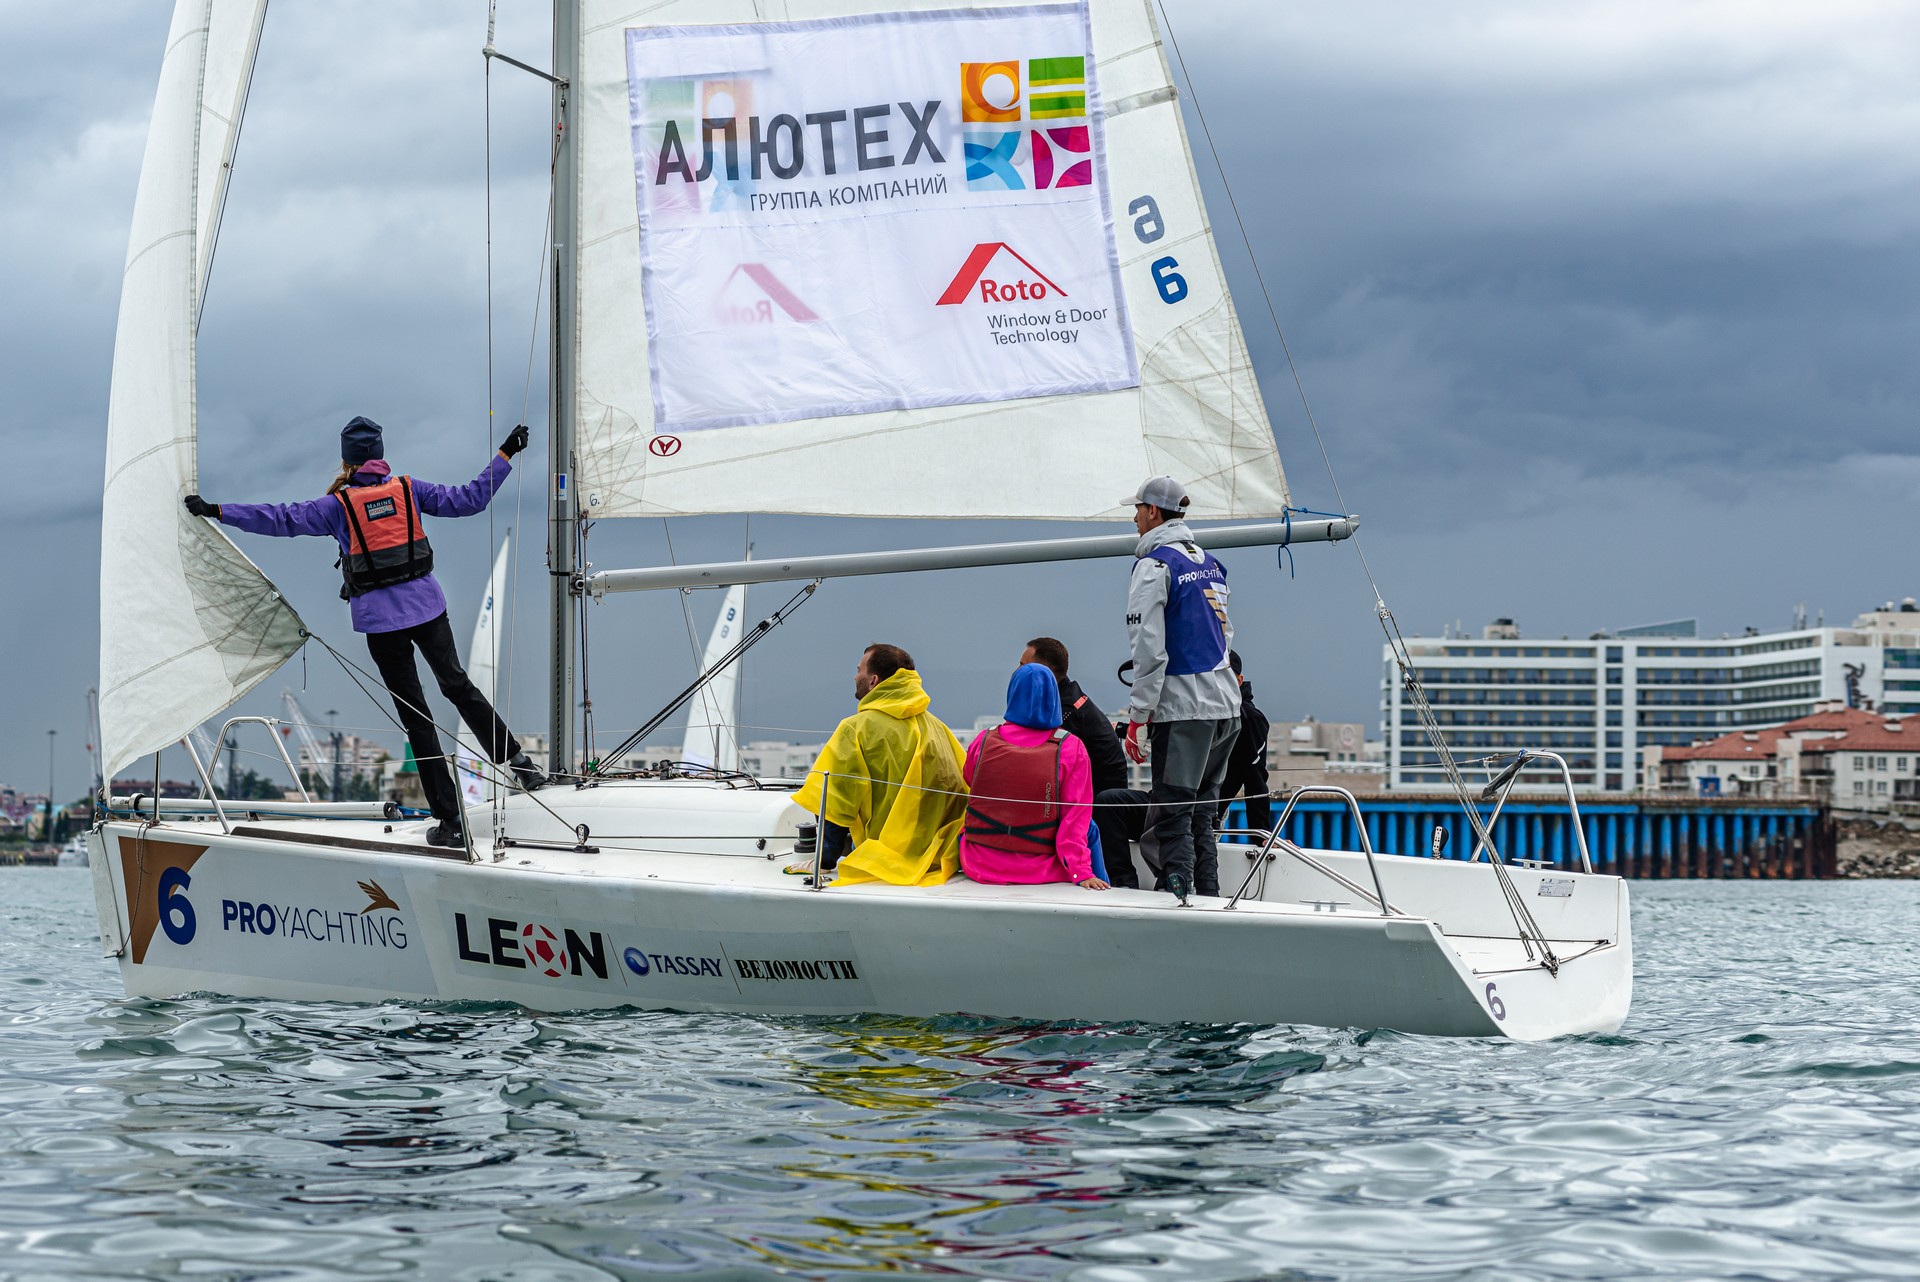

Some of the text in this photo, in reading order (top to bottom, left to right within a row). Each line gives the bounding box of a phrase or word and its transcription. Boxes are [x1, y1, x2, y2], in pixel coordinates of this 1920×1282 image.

[655, 100, 947, 185] АЛЮТЕХ
[750, 173, 948, 212] ГРУППА КОМПАНИЙ
[980, 279, 1047, 303] Roto
[1151, 255, 1189, 305] 6
[987, 307, 1108, 328] Window & Door
[990, 328, 1079, 345] Technology
[1178, 569, 1225, 585] PROYACHTIN
[726, 607, 736, 622] 8
[1126, 613, 1142, 625] HH
[158, 866, 197, 945] 6
[222, 900, 408, 949] PROYACHTING
[648, 953, 724, 978] TASSAY
[735, 959, 860, 983] ВЕДОМОСТИ
[1486, 983, 1506, 1021] 6
